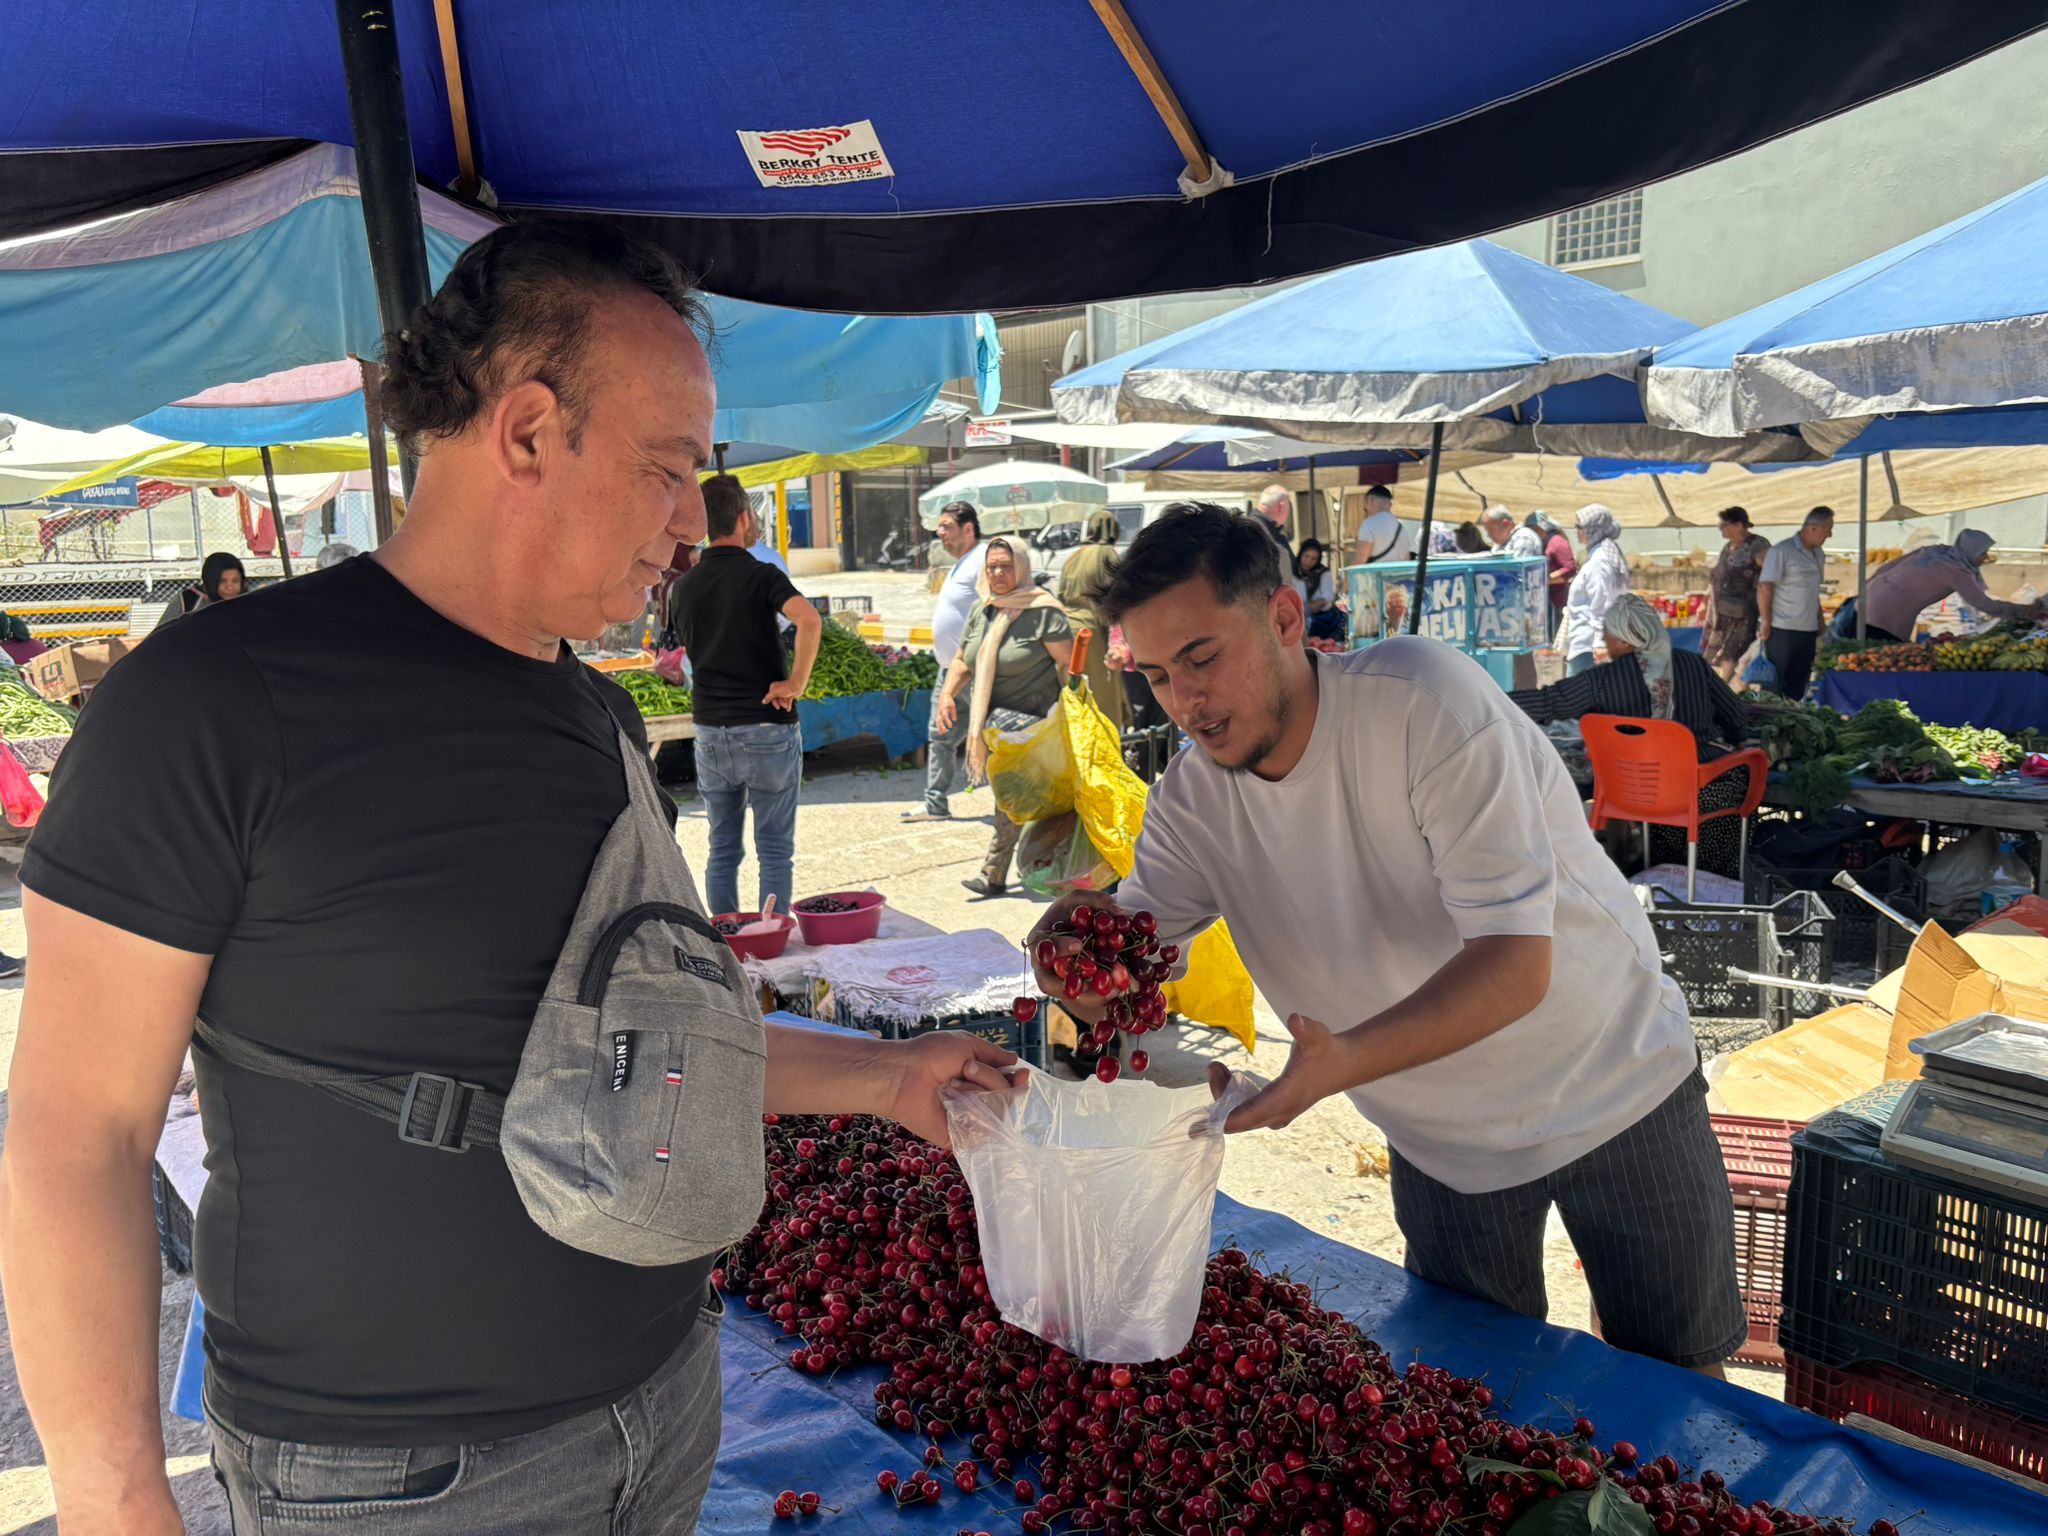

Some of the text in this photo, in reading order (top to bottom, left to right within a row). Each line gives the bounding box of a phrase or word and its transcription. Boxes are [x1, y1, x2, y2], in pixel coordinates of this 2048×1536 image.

[758, 157, 821, 170] BERKAY
[826, 150, 880, 165] TENTE
[1433, 574, 1496, 611] KAR
